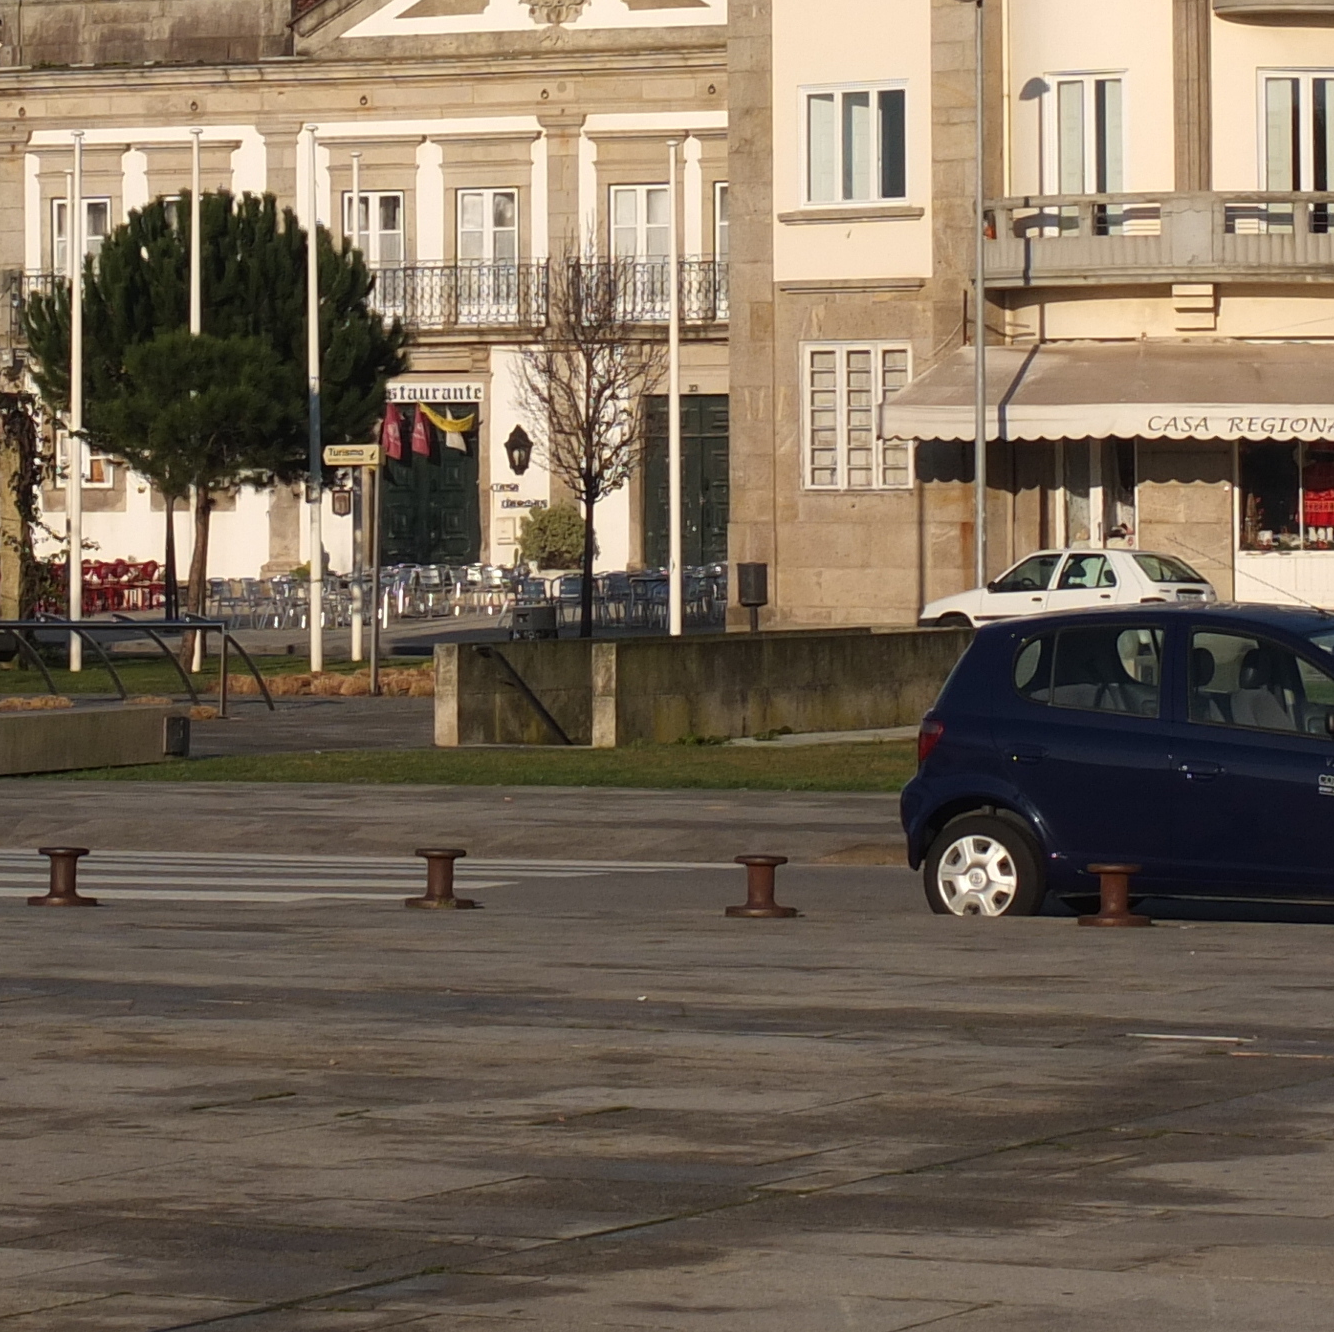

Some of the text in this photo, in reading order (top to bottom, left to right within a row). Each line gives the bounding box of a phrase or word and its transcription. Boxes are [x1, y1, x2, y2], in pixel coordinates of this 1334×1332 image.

[387, 384, 483, 401] staurante
[1147, 415, 1210, 432] CASA
[327, 448, 364, 457] Turismo
